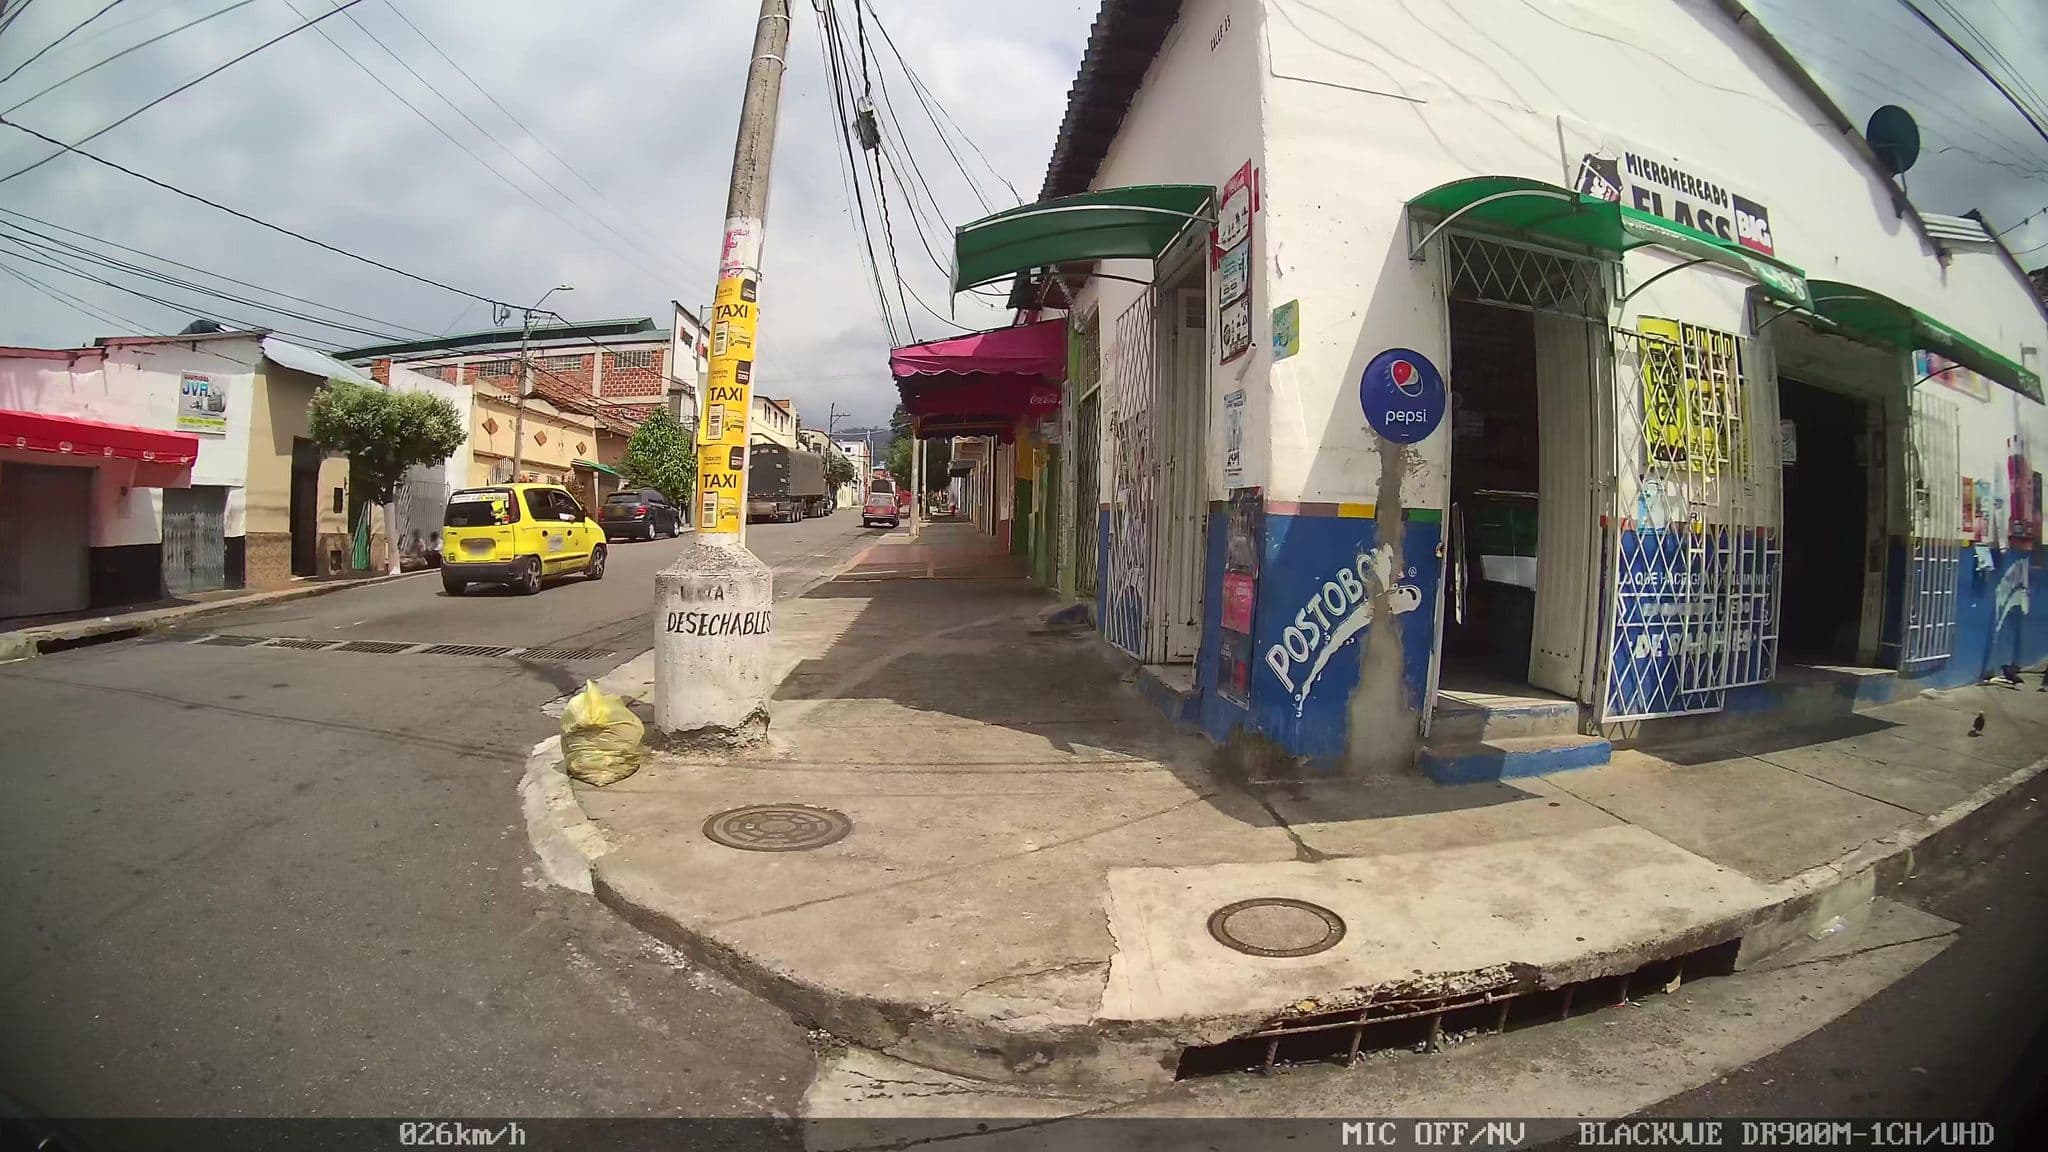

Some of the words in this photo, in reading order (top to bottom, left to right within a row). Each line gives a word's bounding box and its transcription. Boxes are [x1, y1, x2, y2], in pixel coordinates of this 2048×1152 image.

[1625, 152, 1728, 209] MICROMERCADO
[1736, 209, 1772, 249] BIG
[715, 304, 748, 320] TAXI
[709, 387, 743, 402] TAXI
[1385, 409, 1427, 425] pepsi
[703, 474, 737, 488] TAXI
[1635, 572, 1658, 585] QUE
